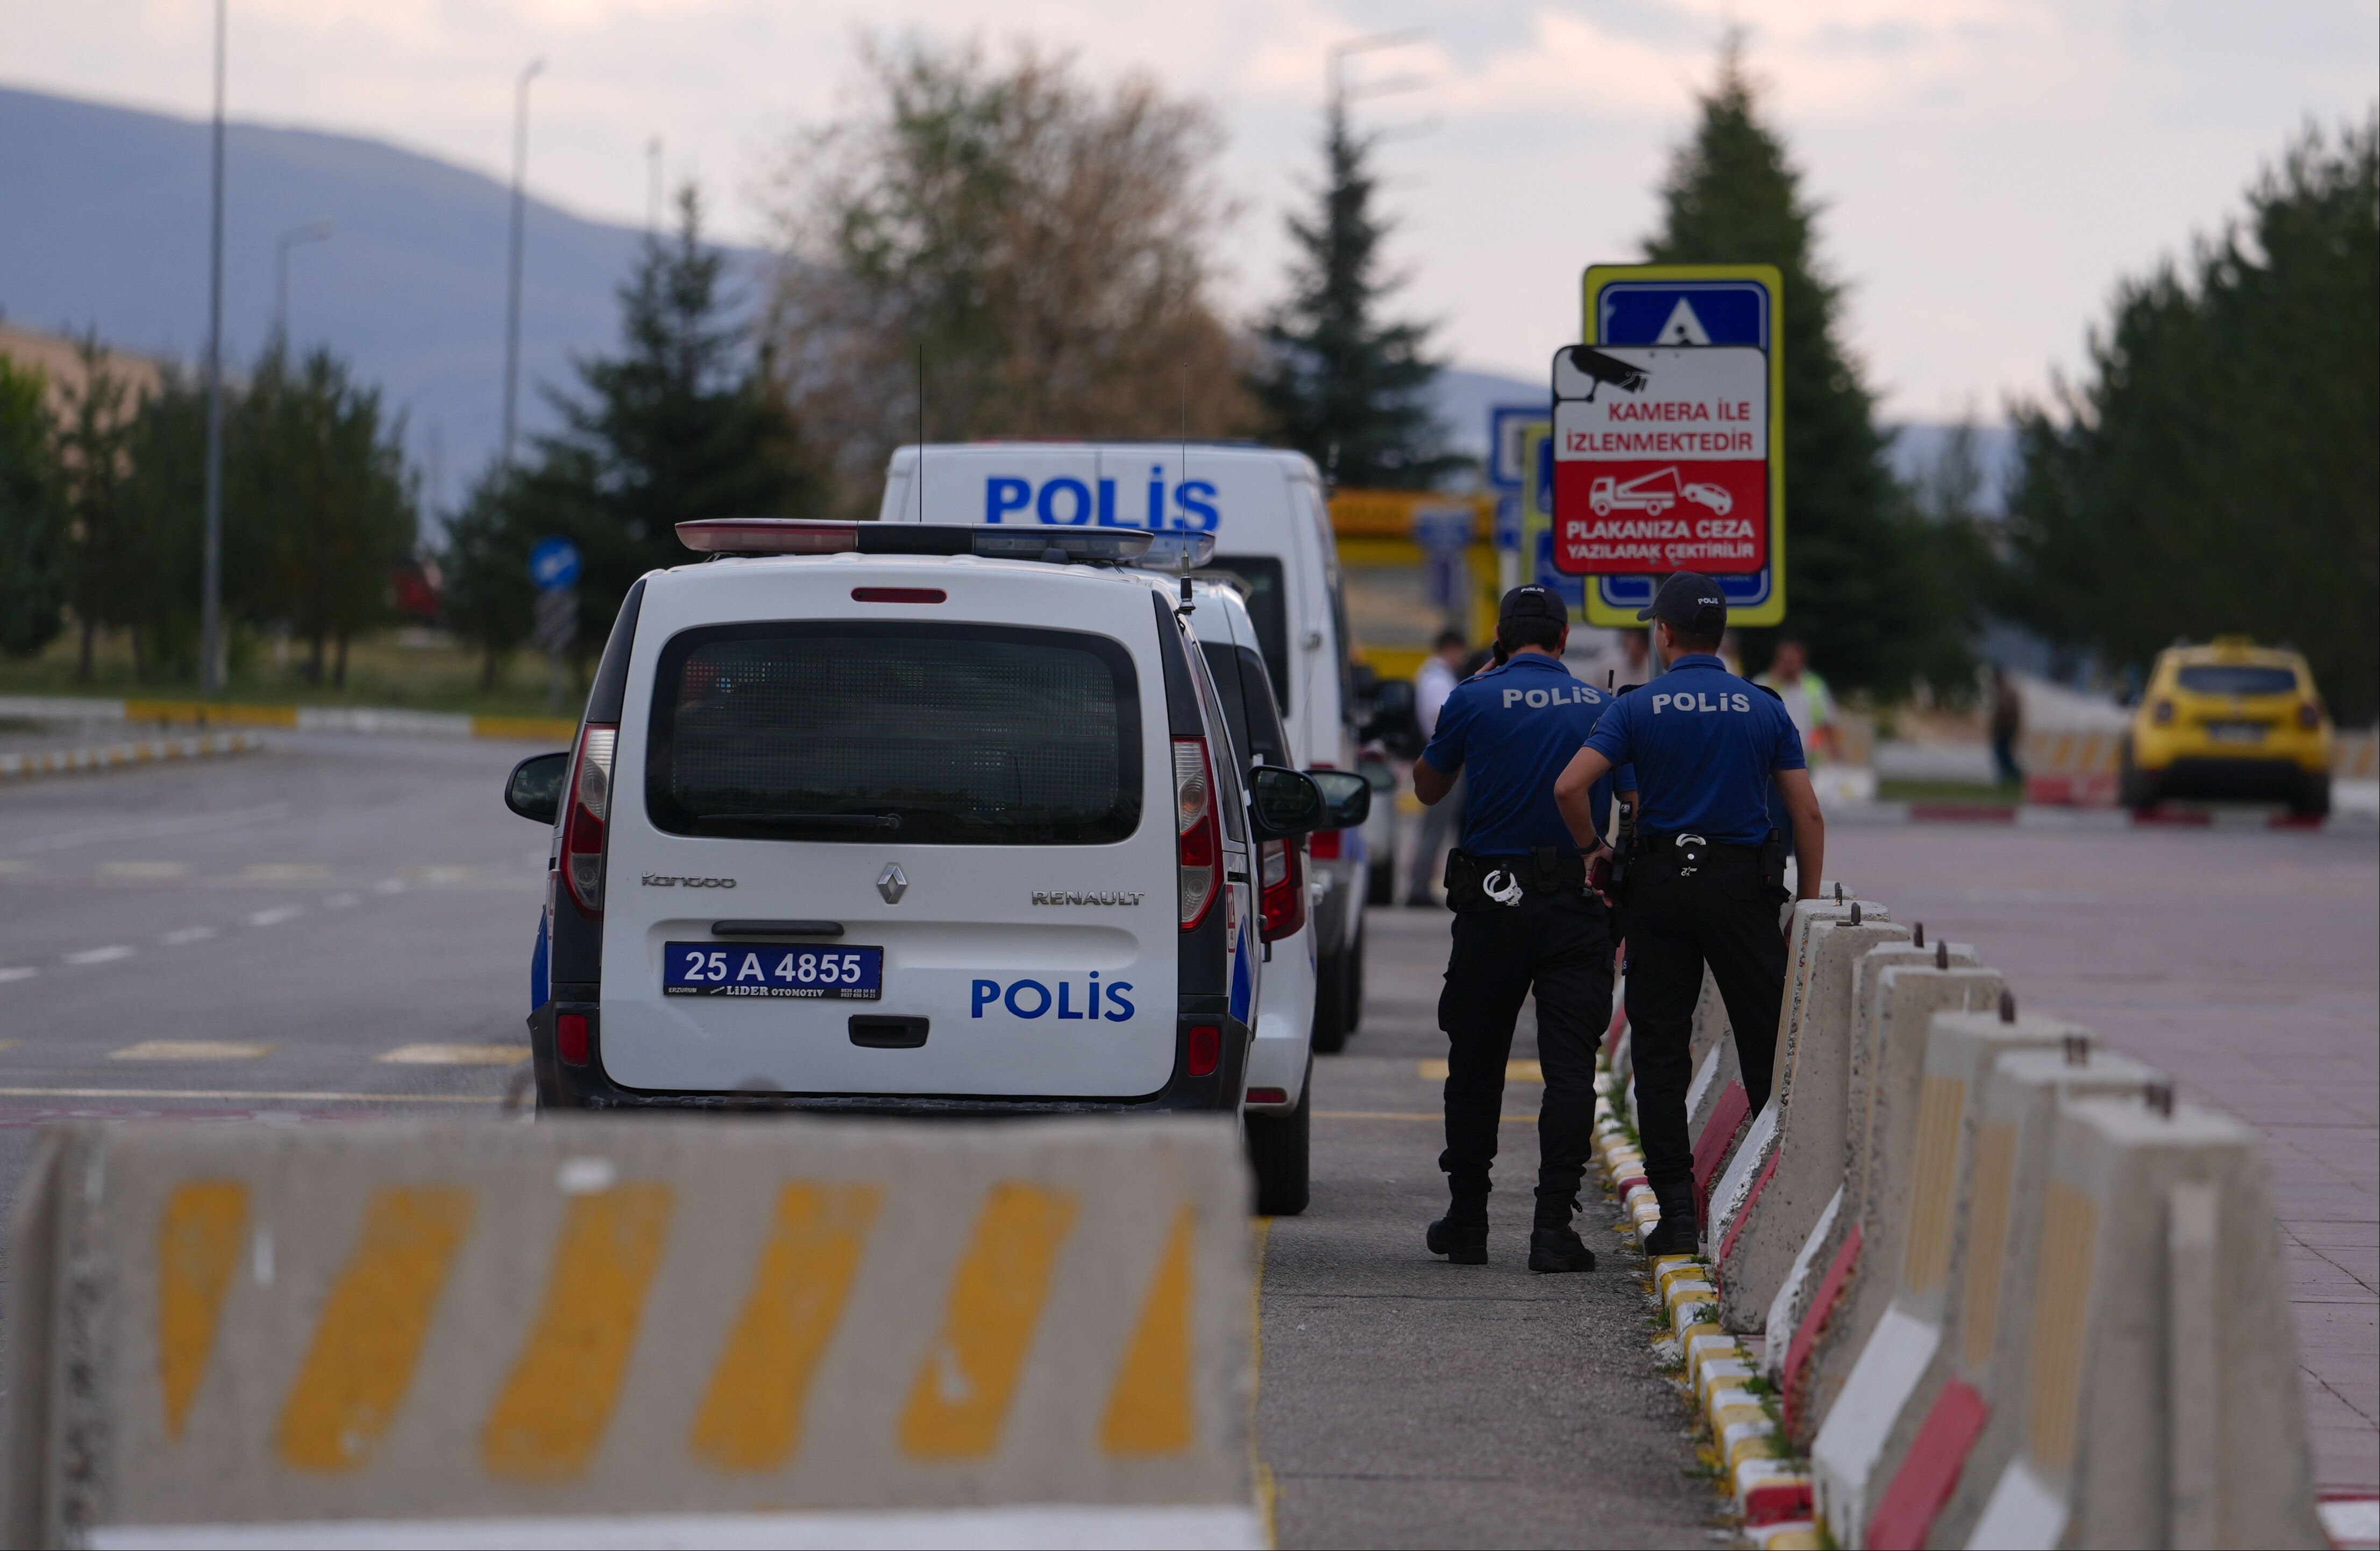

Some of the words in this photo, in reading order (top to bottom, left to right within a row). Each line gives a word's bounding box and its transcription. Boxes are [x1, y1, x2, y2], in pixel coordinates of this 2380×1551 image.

[1609, 402, 1710, 422] KAMERA
[1717, 397, 1751, 422] İLE
[1566, 427, 1753, 452] İZLENMEKTEDİR
[986, 464, 1220, 532] POLİS
[1566, 520, 1690, 539] PLAKANIZA
[1695, 520, 1754, 539] CEZA
[1566, 543, 1661, 559] YAZILARAK
[1032, 890, 1145, 905] RENAULT
[684, 952, 727, 981] 25
[736, 953, 765, 981] A
[775, 953, 861, 983] 4855
[971, 971, 1135, 1022] POLİS
